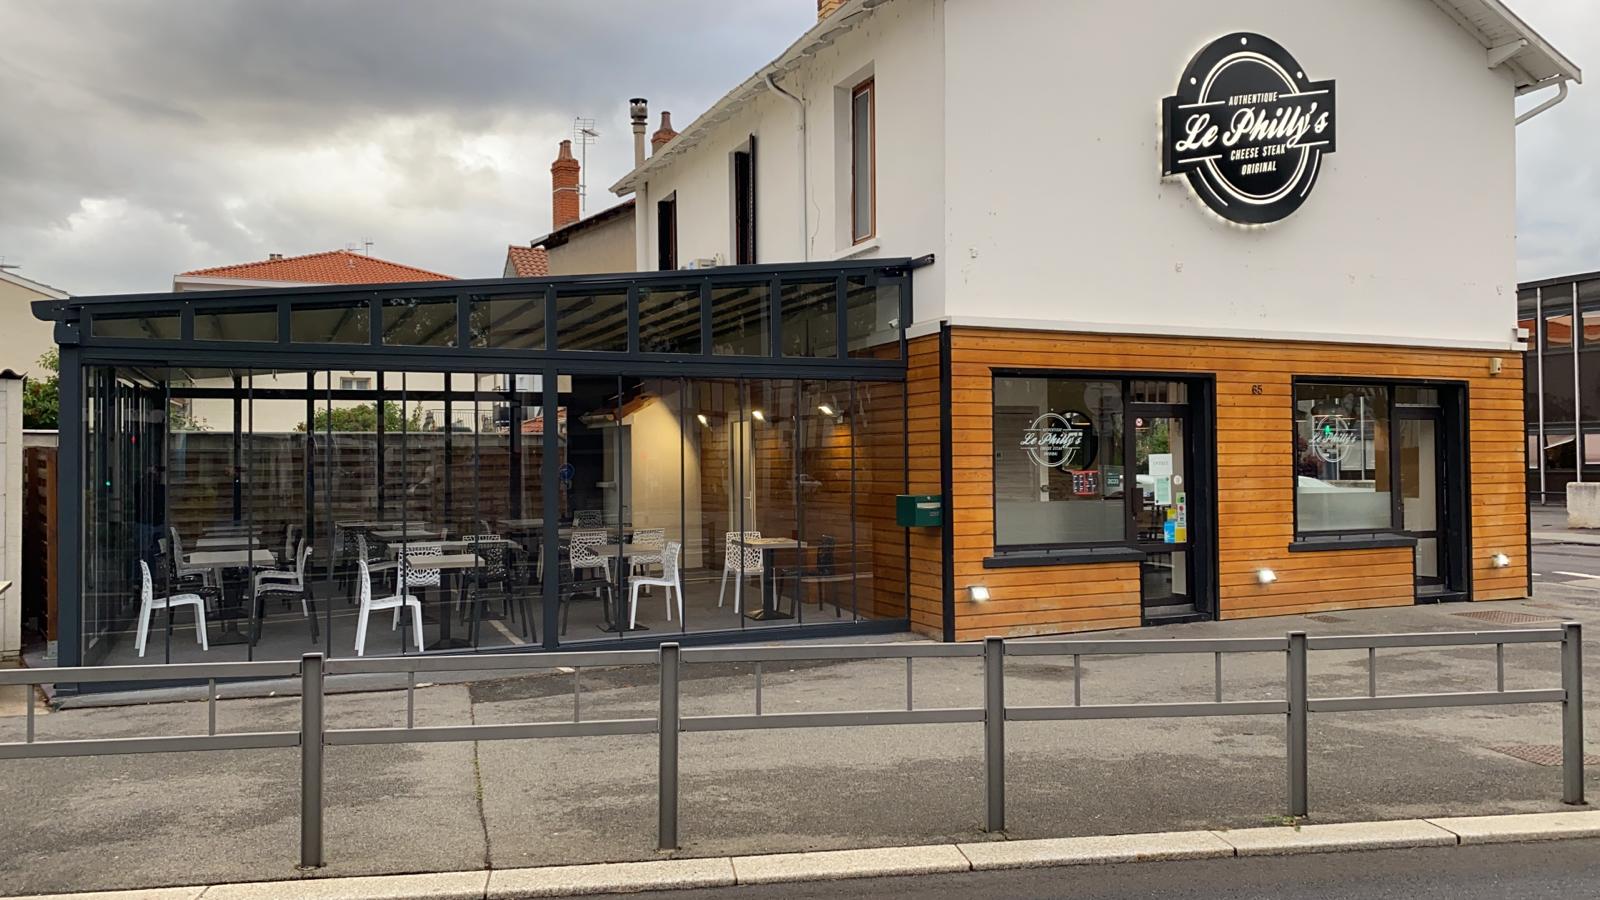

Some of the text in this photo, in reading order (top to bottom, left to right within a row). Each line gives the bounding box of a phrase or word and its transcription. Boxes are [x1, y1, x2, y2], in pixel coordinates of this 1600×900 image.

[1228, 91, 1278, 106] AUTHENTIQUE
[1175, 101, 1329, 151] Le Philly's
[1230, 144, 1286, 161] CHEESE STEAK
[1241, 160, 1277, 176] ORIGINAL
[1251, 384, 1263, 395] 65
[1020, 432, 1038, 445] Le
